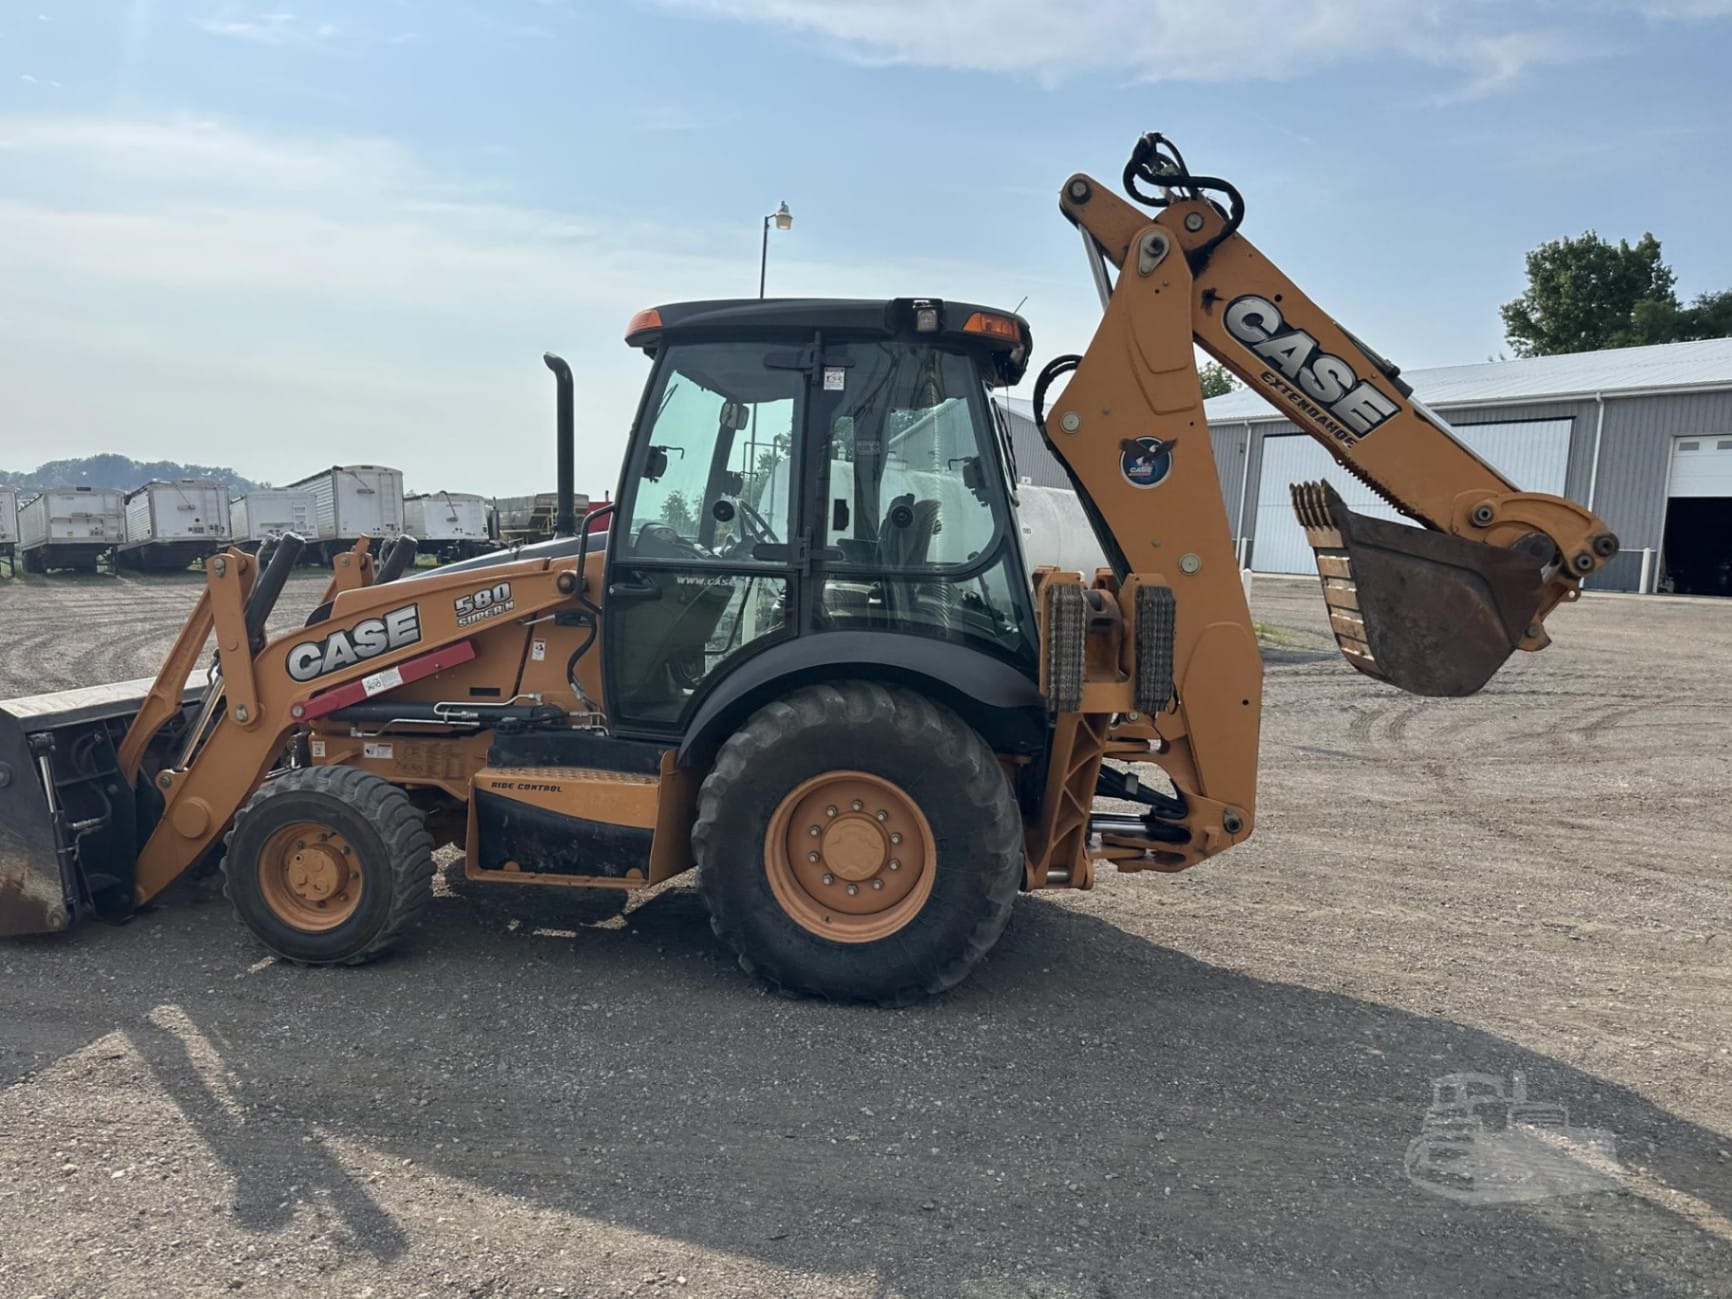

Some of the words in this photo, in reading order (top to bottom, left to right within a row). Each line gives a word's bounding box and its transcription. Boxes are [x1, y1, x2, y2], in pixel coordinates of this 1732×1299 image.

[1224, 294, 1402, 438] CASE
[1260, 371, 1358, 448] EXTENDAHOE
[455, 582, 511, 617] 580
[457, 604, 504, 628] SUPER
[286, 603, 421, 682] CASE
[517, 783, 563, 792] CONTROL
